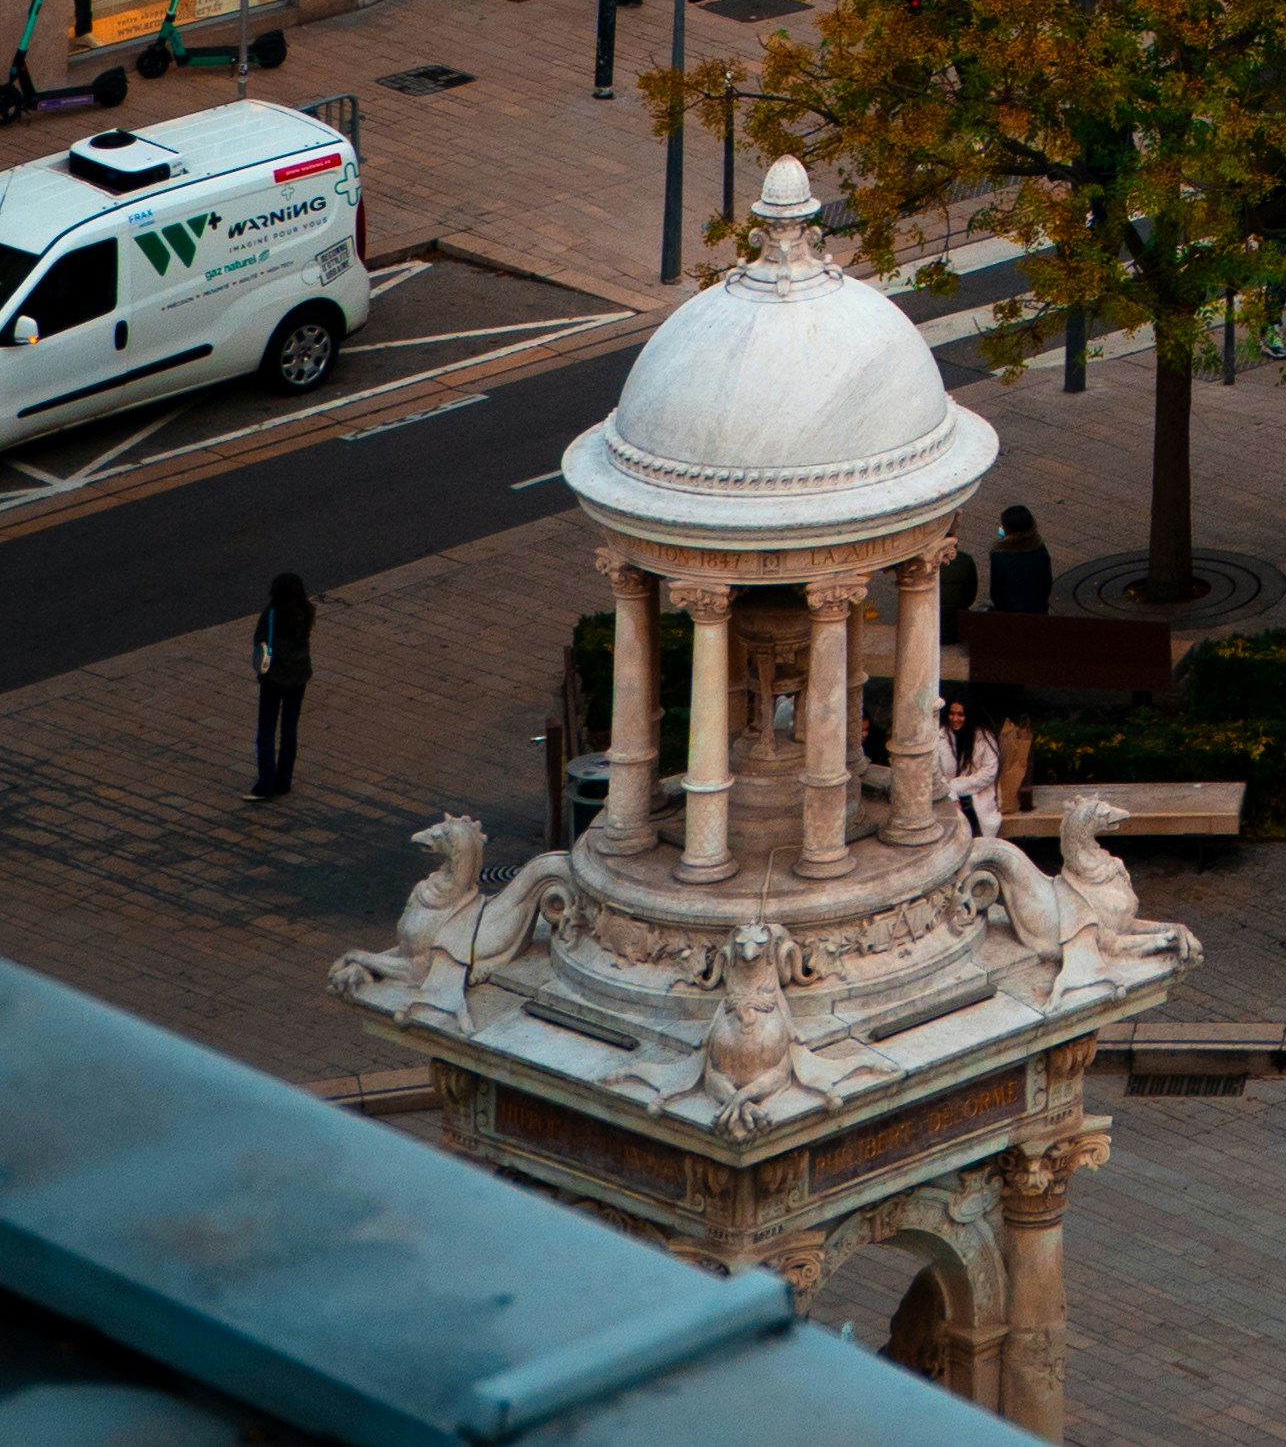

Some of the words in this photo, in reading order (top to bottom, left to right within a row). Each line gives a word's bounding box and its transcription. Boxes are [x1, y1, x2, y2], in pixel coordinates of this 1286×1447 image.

[229, 235, 269, 254] IMAGINE
[273, 226, 299, 240] POUR
[302, 216, 329, 230] VOUS
[205, 265, 222, 282] gaz
[223, 254, 257, 274] naturel
